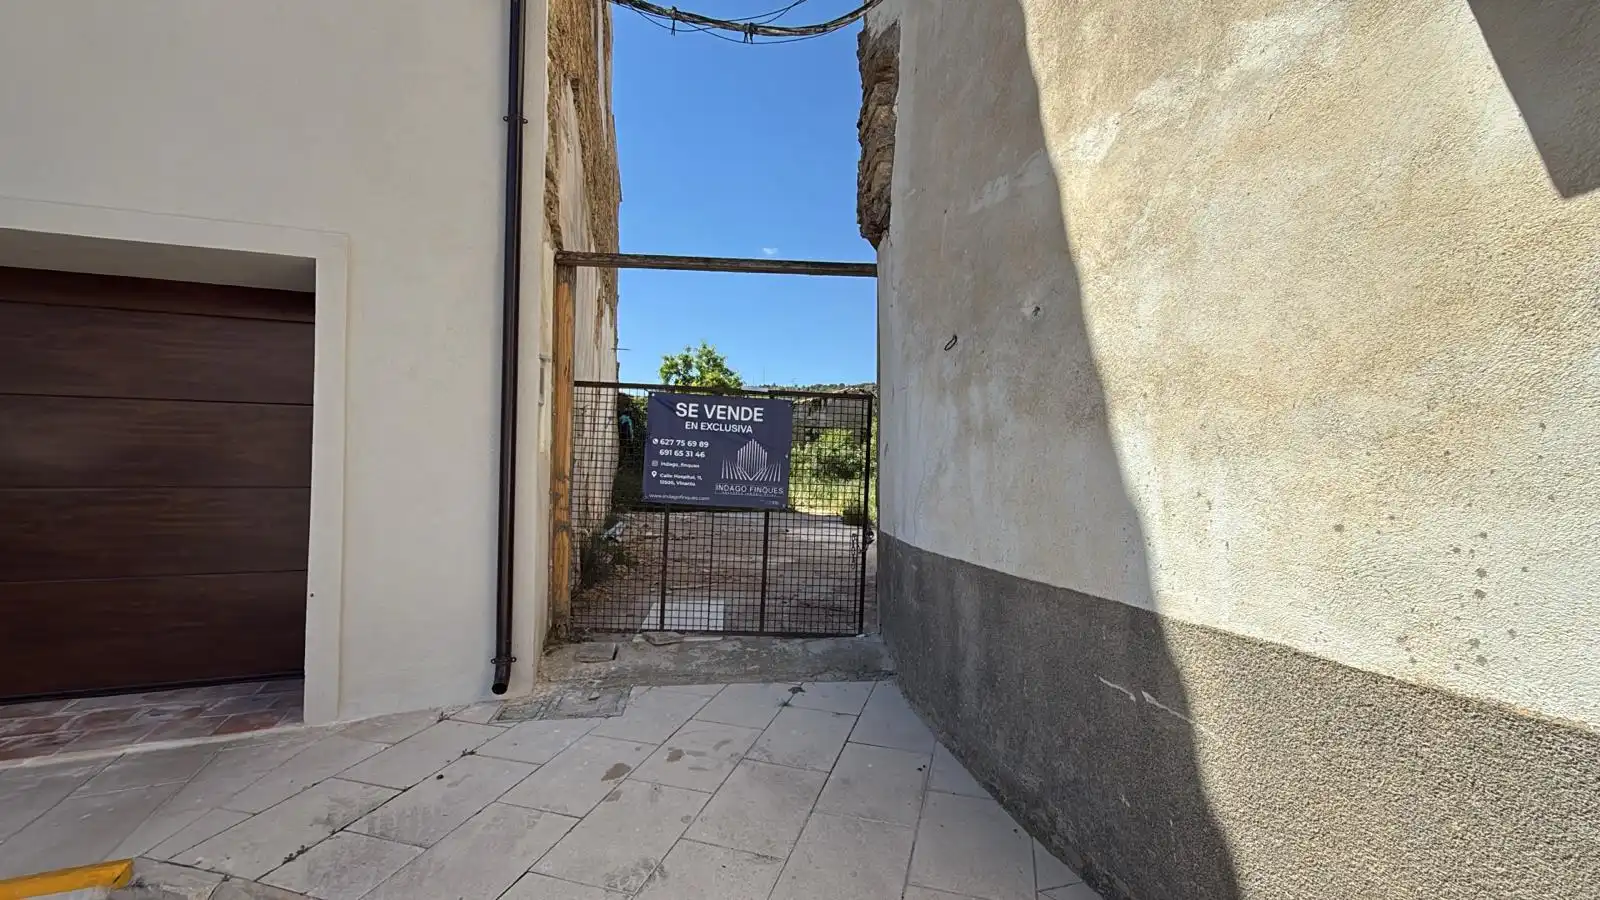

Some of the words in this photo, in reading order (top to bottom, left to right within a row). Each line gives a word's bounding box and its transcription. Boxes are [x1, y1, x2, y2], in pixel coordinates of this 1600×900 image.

[676, 403, 699, 417] SE
[704, 404, 764, 421] VENDE
[685, 421, 698, 430] EN
[701, 422, 753, 433] EXCLUSIVA
[715, 484, 747, 492] INDAGO
[749, 486, 784, 494] FINQUES
